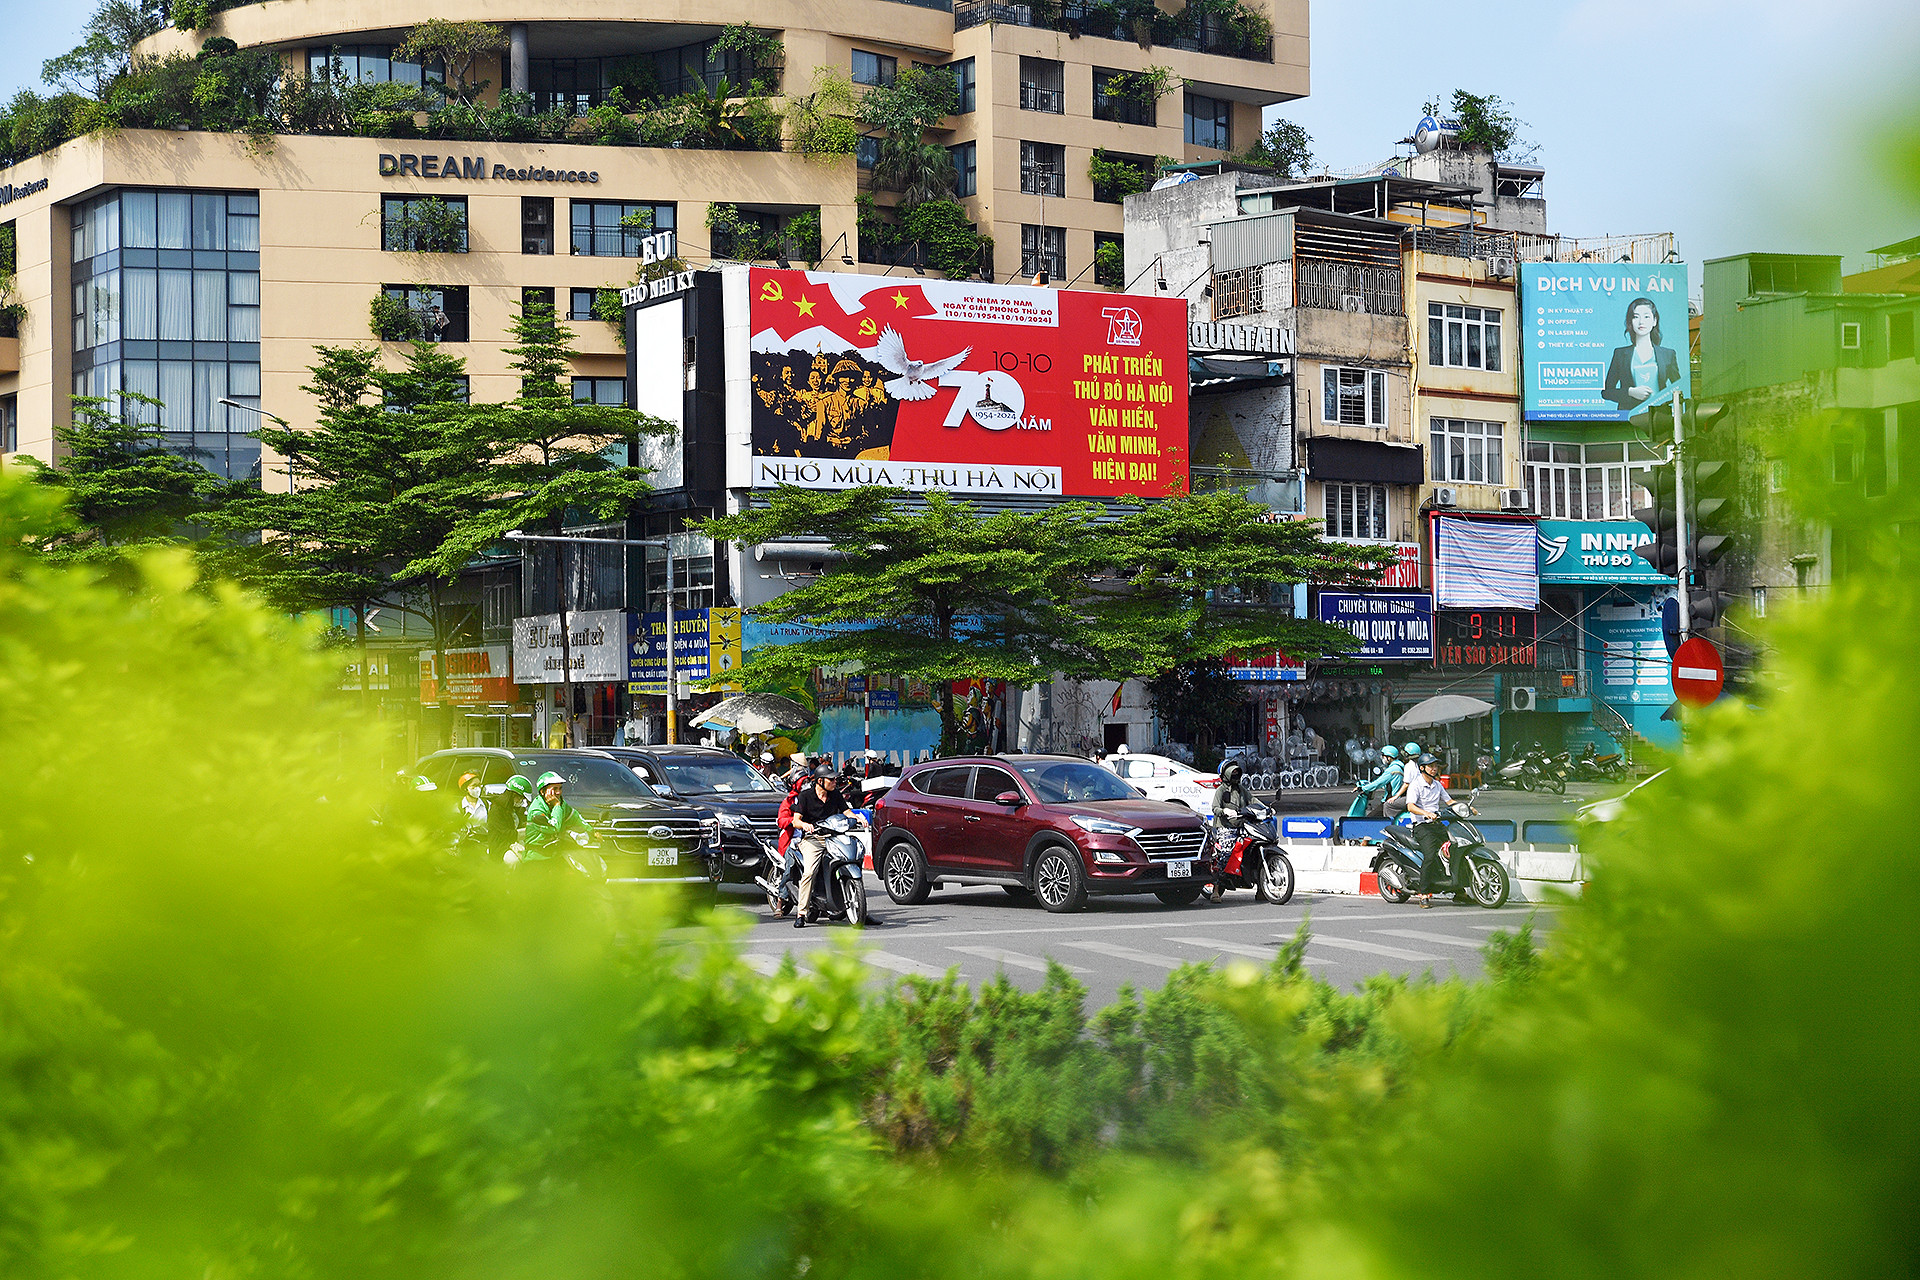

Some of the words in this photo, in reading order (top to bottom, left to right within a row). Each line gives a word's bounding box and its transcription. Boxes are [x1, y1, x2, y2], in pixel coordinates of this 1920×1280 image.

[378, 153, 485, 179] DREAM
[492, 164, 599, 184] Residences
[641, 231, 673, 266] EU
[1537, 276, 1582, 296] DỊCH
[1588, 277, 1616, 296] VỤ
[1621, 277, 1640, 292] IN
[1646, 270, 1674, 293] ẤN
[1191, 321, 1296, 355] OUNTAIN
[993, 351, 1052, 373] 10-10
[1083, 351, 1120, 375] PHÁT
[1122, 351, 1163, 377] TRIỂN
[1543, 367, 1556, 378] IN
[1556, 367, 1599, 378] NHANH
[1073, 375, 1100, 400] THỦ
[1104, 379, 1123, 401] ĐÔ
[1127, 380, 1146, 402] HÀ
[1149, 381, 1173, 407] NỘI
[1544, 377, 1559, 386] THỦ
[938, 369, 1026, 431] 70
[975, 411, 1017, 420] 1954-2024
[1016, 415, 1052, 431] NĂM
[1089, 404, 1119, 428] VĂN
[1121, 404, 1159, 431] HIẾN,
[1087, 430, 1116, 454] VĂN
[1120, 435, 1162, 457] MINH,
[761, 460, 822, 482] NHỚ
[832, 463, 894, 485] MÙA
[902, 467, 958, 487] THU
[966, 467, 1004, 488] HÀ
[1013, 468, 1058, 492] NỘI
[1092, 458, 1126, 485] HIỆN
[1128, 462, 1158, 485] ĐẠI!
[1581, 533, 1603, 552] IN
[1581, 551, 1609, 567] THỦ
[1611, 553, 1633, 567] ĐÔ
[1398, 556, 1419, 588] SƠN
[1338, 599, 1367, 613] CHUYÊN
[1369, 601, 1388, 613] KINH
[1390, 600, 1415, 614] DOANH
[651, 621, 679, 636] THAH
[680, 612, 708, 634] HUYỀN
[780, 628, 800, 636] TRUNG
[1371, 619, 1396, 645] QUẠT
[1398, 620, 1405, 641] 4
[1406, 616, 1429, 641] MÙA
[527, 626, 549, 649] EU
[673, 639, 688, 652] ĐIỆN
[688, 640, 693, 649] 4
[694, 636, 708, 649] MÙA
[432, 651, 492, 676] TSHIBA
[1440, 637, 1462, 665] YẾN
[1490, 641, 1508, 665] SÀI
[1511, 641, 1534, 665] GÒN
[1171, 786, 1202, 794] UTOUR
